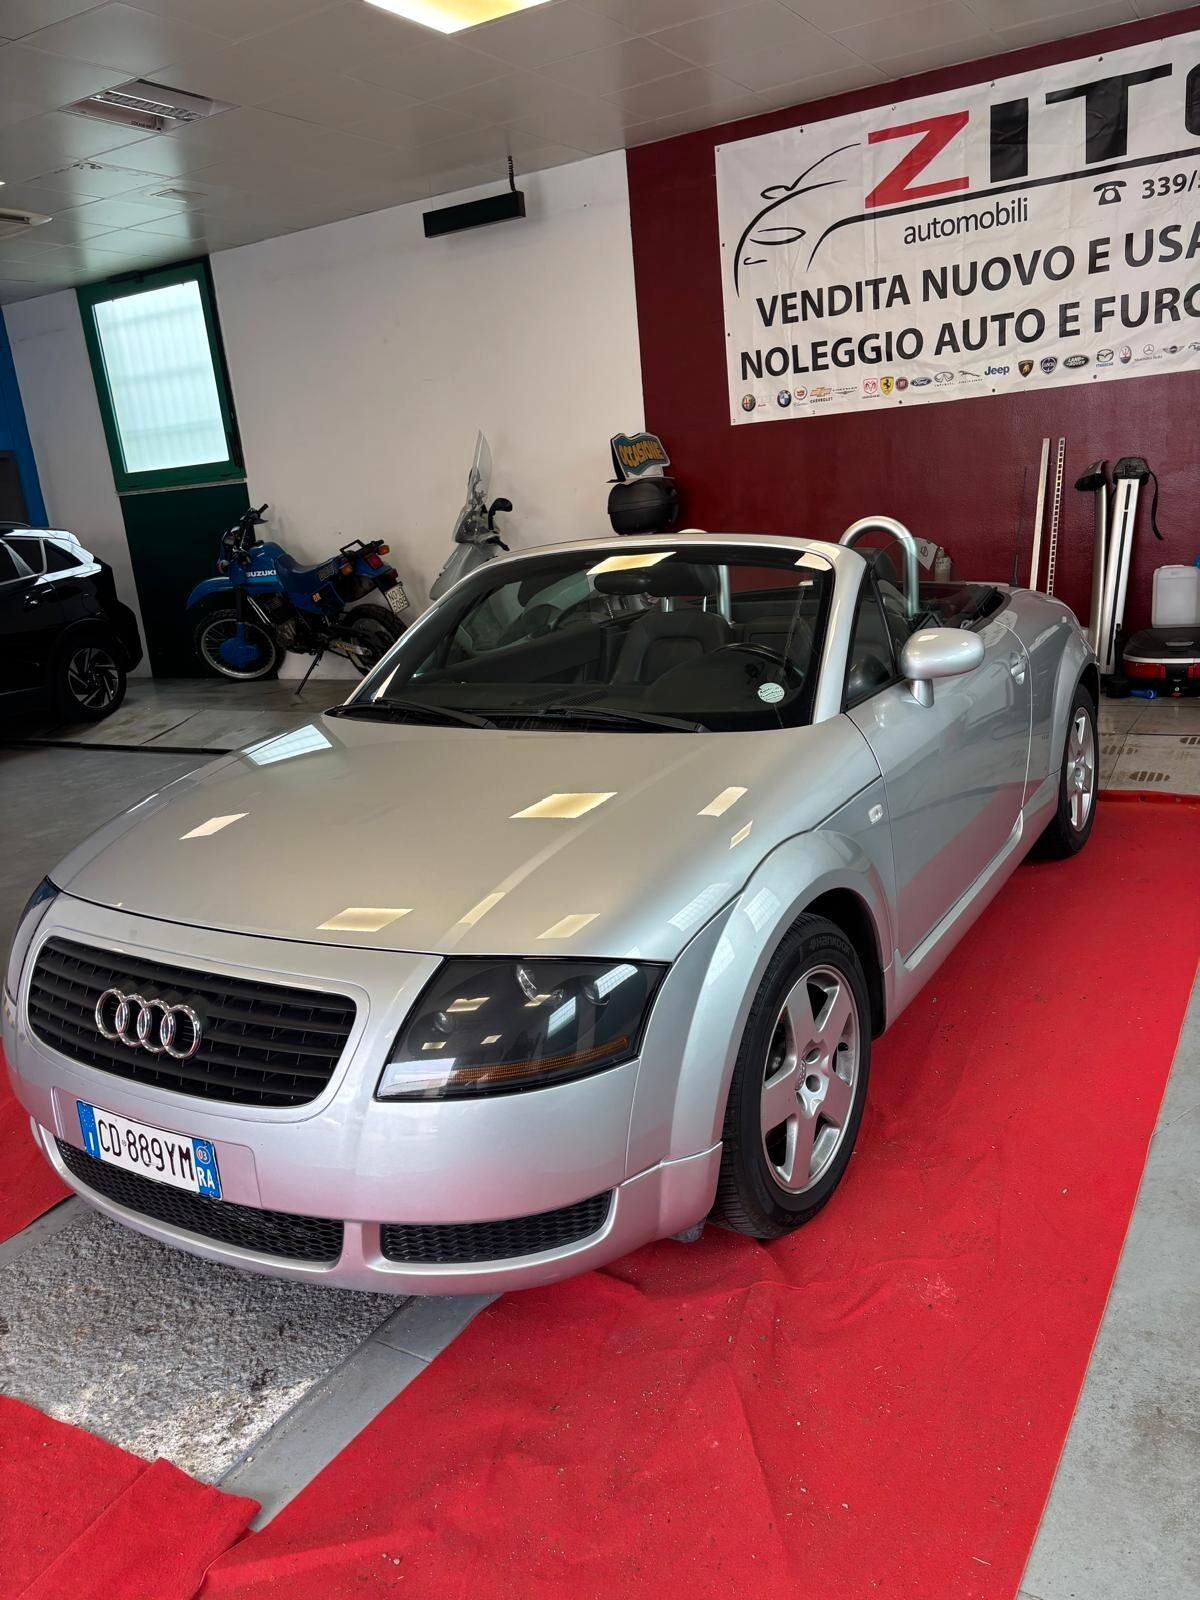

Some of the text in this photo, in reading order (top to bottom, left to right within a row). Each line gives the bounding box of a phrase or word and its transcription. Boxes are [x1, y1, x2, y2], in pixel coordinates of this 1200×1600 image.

[865, 64, 1200, 208] ZIT
[1142, 170, 1200, 199] 339/
[904, 198, 1028, 244] automobili
[756, 274, 911, 327] VENDITA
[922, 244, 1075, 302] NUOVO
[1088, 237, 1110, 274] E
[740, 327, 924, 380] NOLEGGIO
[934, 307, 1046, 356] AUTO
[1058, 301, 1081, 339] E
[984, 365, 1010, 376] Jeep
[198, 1166, 215, 1189] RA
